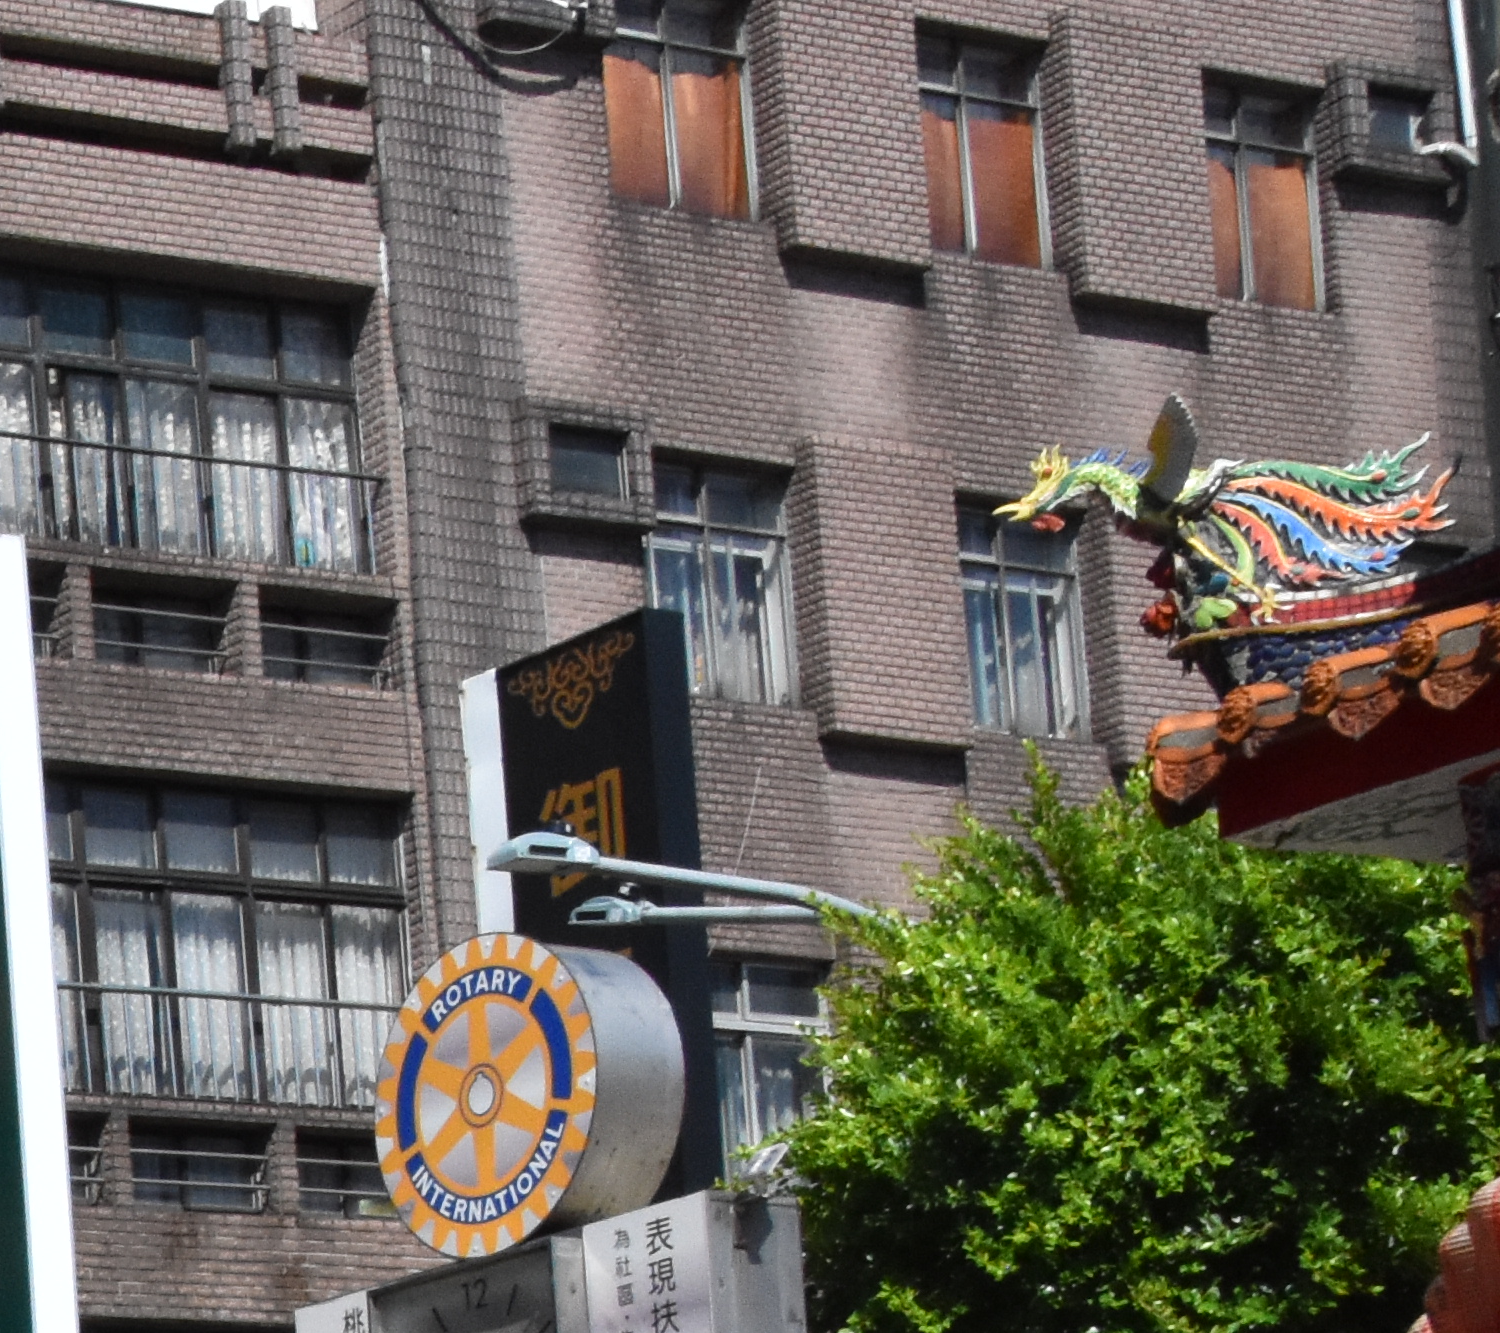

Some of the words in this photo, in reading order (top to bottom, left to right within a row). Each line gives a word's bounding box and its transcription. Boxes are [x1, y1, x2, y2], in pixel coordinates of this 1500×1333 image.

[430, 968, 523, 1023] ROTARY
[411, 1119, 567, 1225] INTERNATIONAL
[460, 1278, 489, 1311] 12
